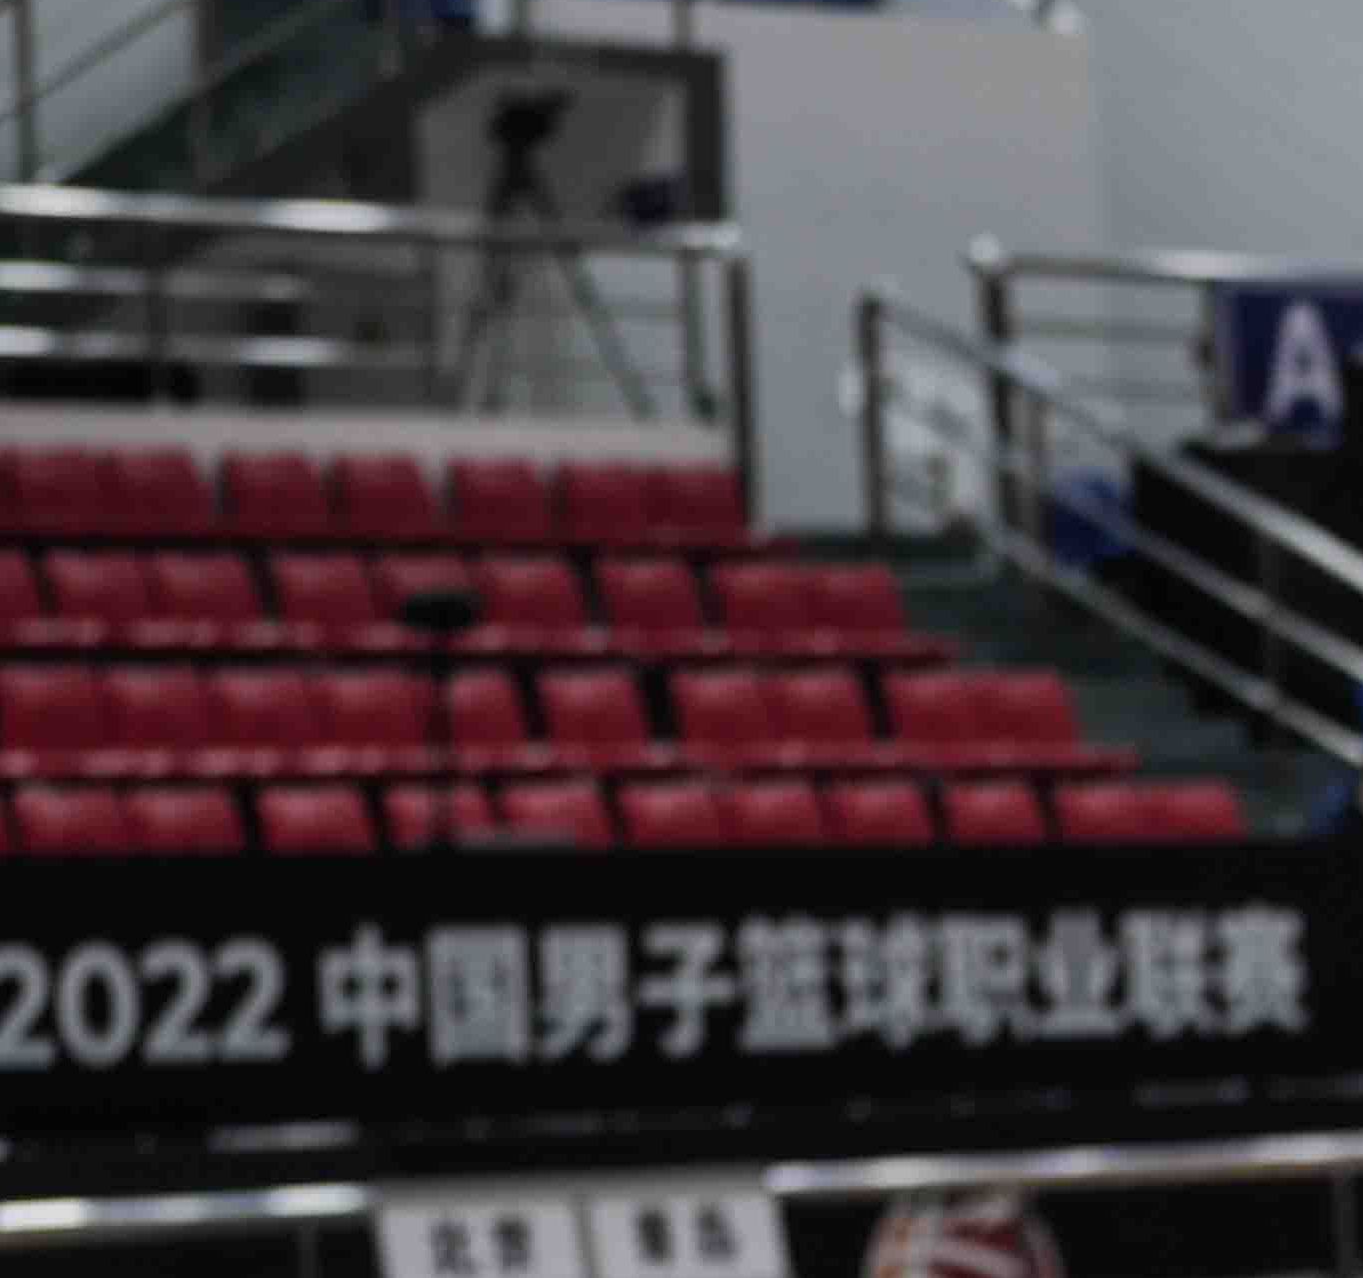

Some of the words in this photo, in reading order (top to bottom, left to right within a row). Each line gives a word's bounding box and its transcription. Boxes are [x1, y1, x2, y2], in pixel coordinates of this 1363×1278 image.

[0, 935, 292, 1070] 2022
[314, 902, 1306, 1070] 中国男子篮球职业联赛
